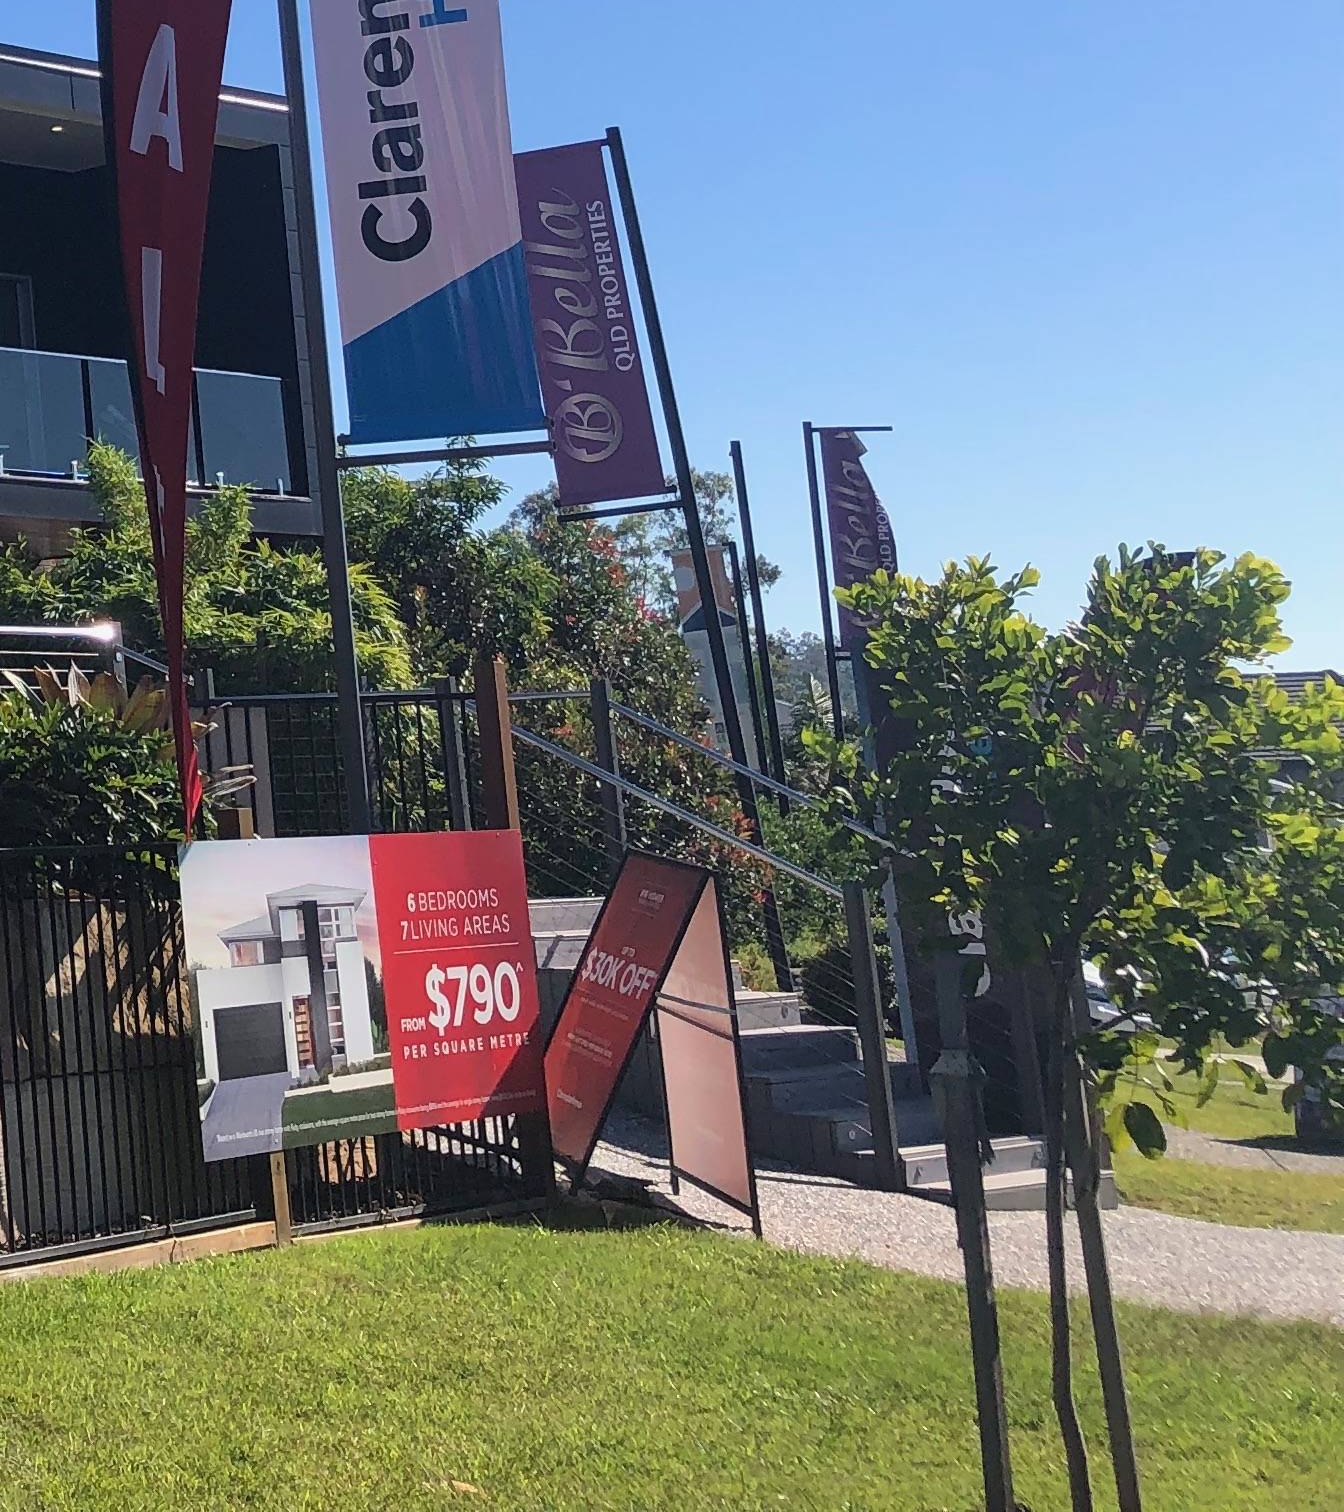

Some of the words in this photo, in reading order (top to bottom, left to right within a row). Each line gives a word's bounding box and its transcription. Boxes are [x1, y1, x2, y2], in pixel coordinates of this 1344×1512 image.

[586, 200, 626, 320] PROPERTIES
[614, 326, 636, 372] QLD
[406, 892, 416, 913] 6
[418, 888, 499, 911] BEDROOMS
[400, 921, 409, 941] 7
[411, 916, 459, 940] LIVING
[463, 913, 511, 935] AREAS
[581, 946, 626, 990] $30K
[401, 1016, 427, 1033] FROM
[403, 1042, 429, 1060] PER
[433, 1036, 486, 1058] SQUARE
[490, 1031, 531, 1051] METRE
